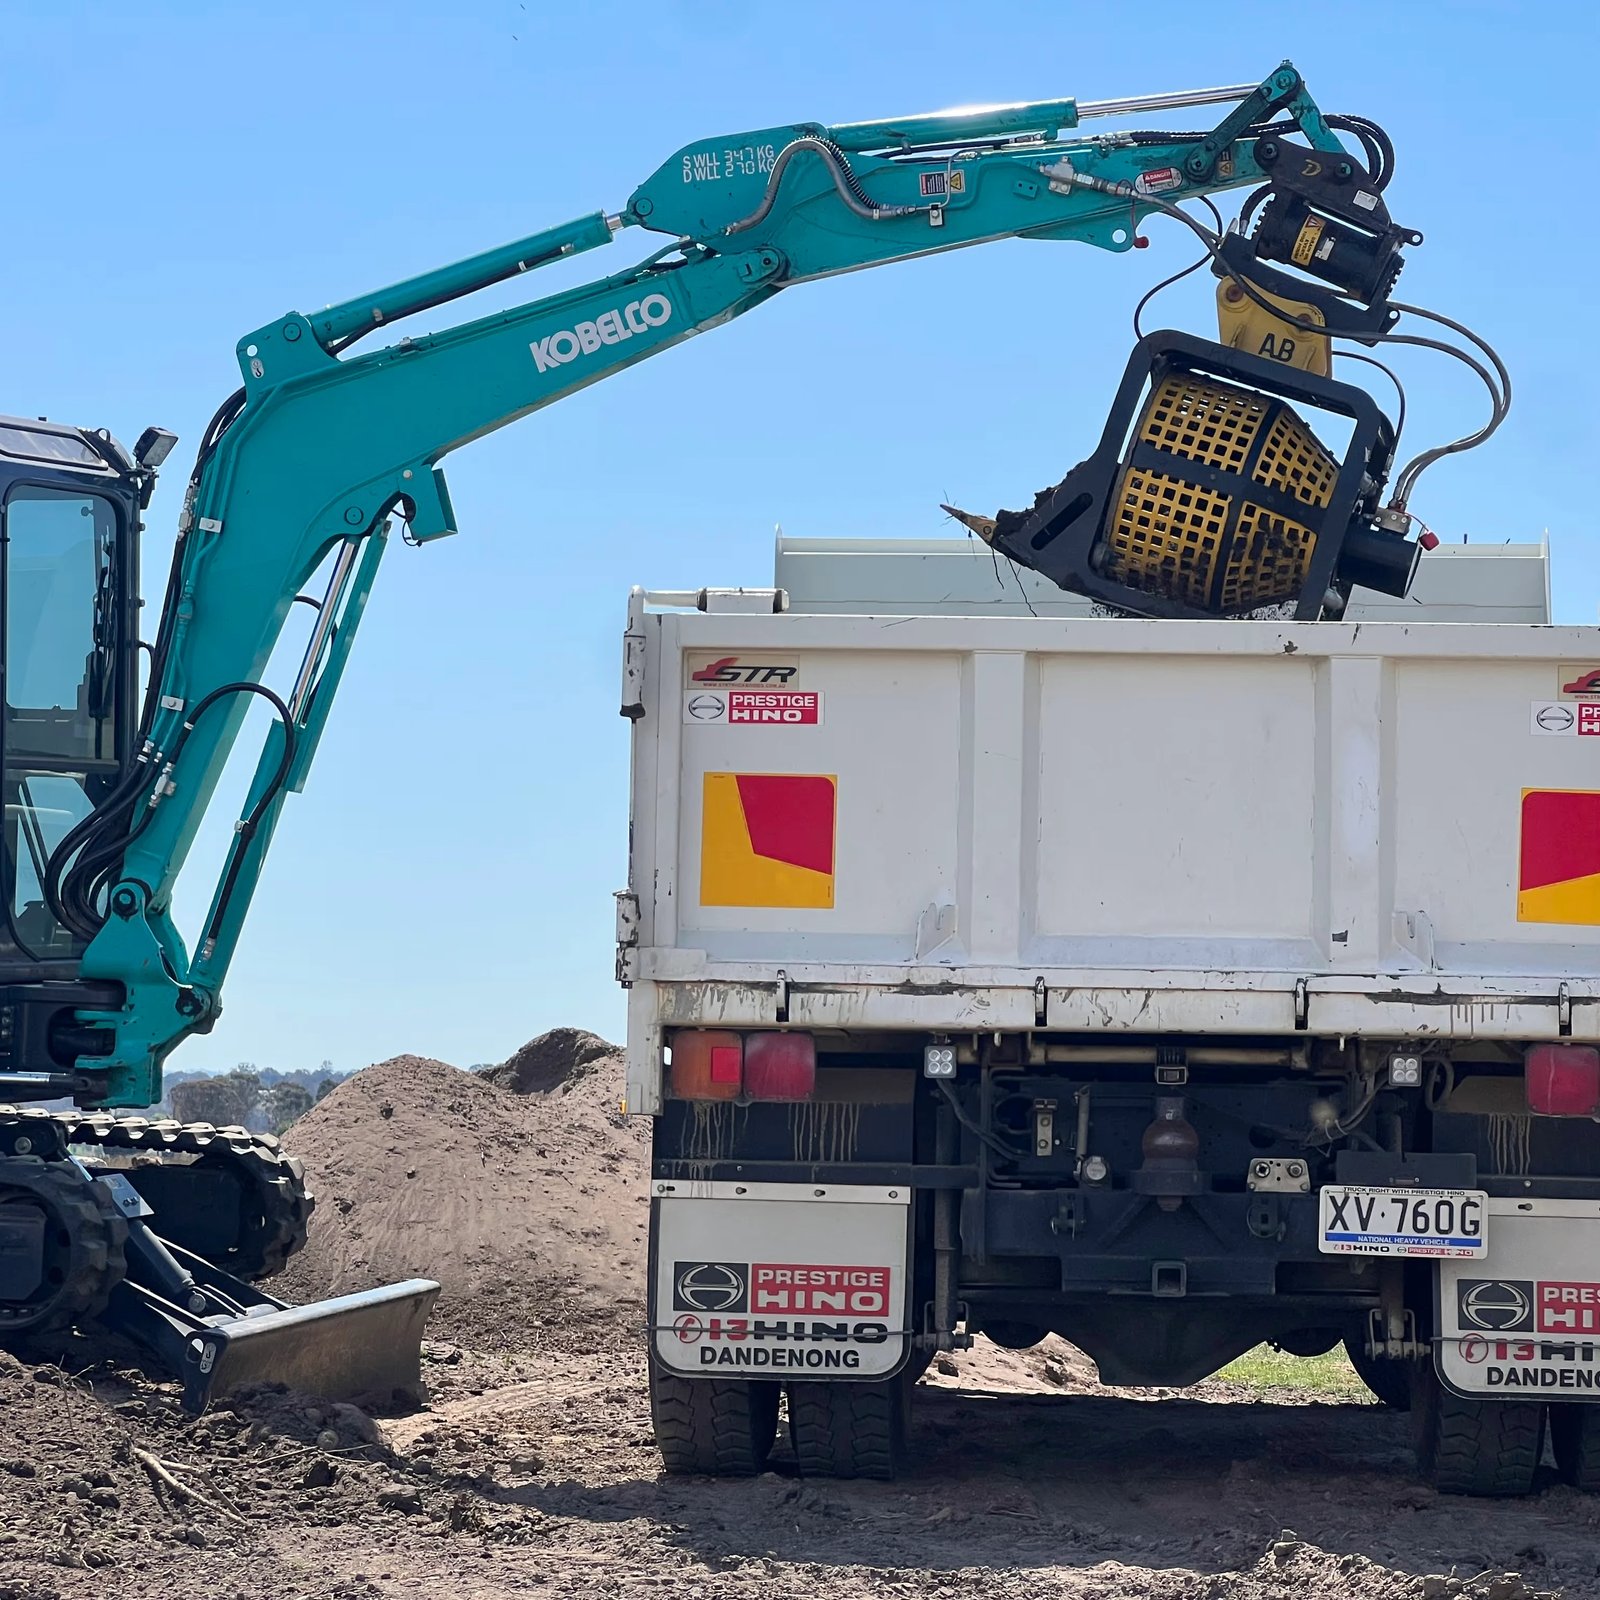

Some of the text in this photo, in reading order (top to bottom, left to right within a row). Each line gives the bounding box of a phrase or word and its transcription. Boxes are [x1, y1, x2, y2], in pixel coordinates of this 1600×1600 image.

[757, 144, 774, 160] KG
[529, 294, 672, 373] KOBELCO
[1258, 333, 1296, 362] AB
[732, 695, 815, 706] PRESTIGE
[732, 710, 802, 722] HINO
[758, 1269, 884, 1287] PRESTIGE
[757, 1290, 883, 1312] HINO
[700, 1346, 860, 1368] DANDENONG
